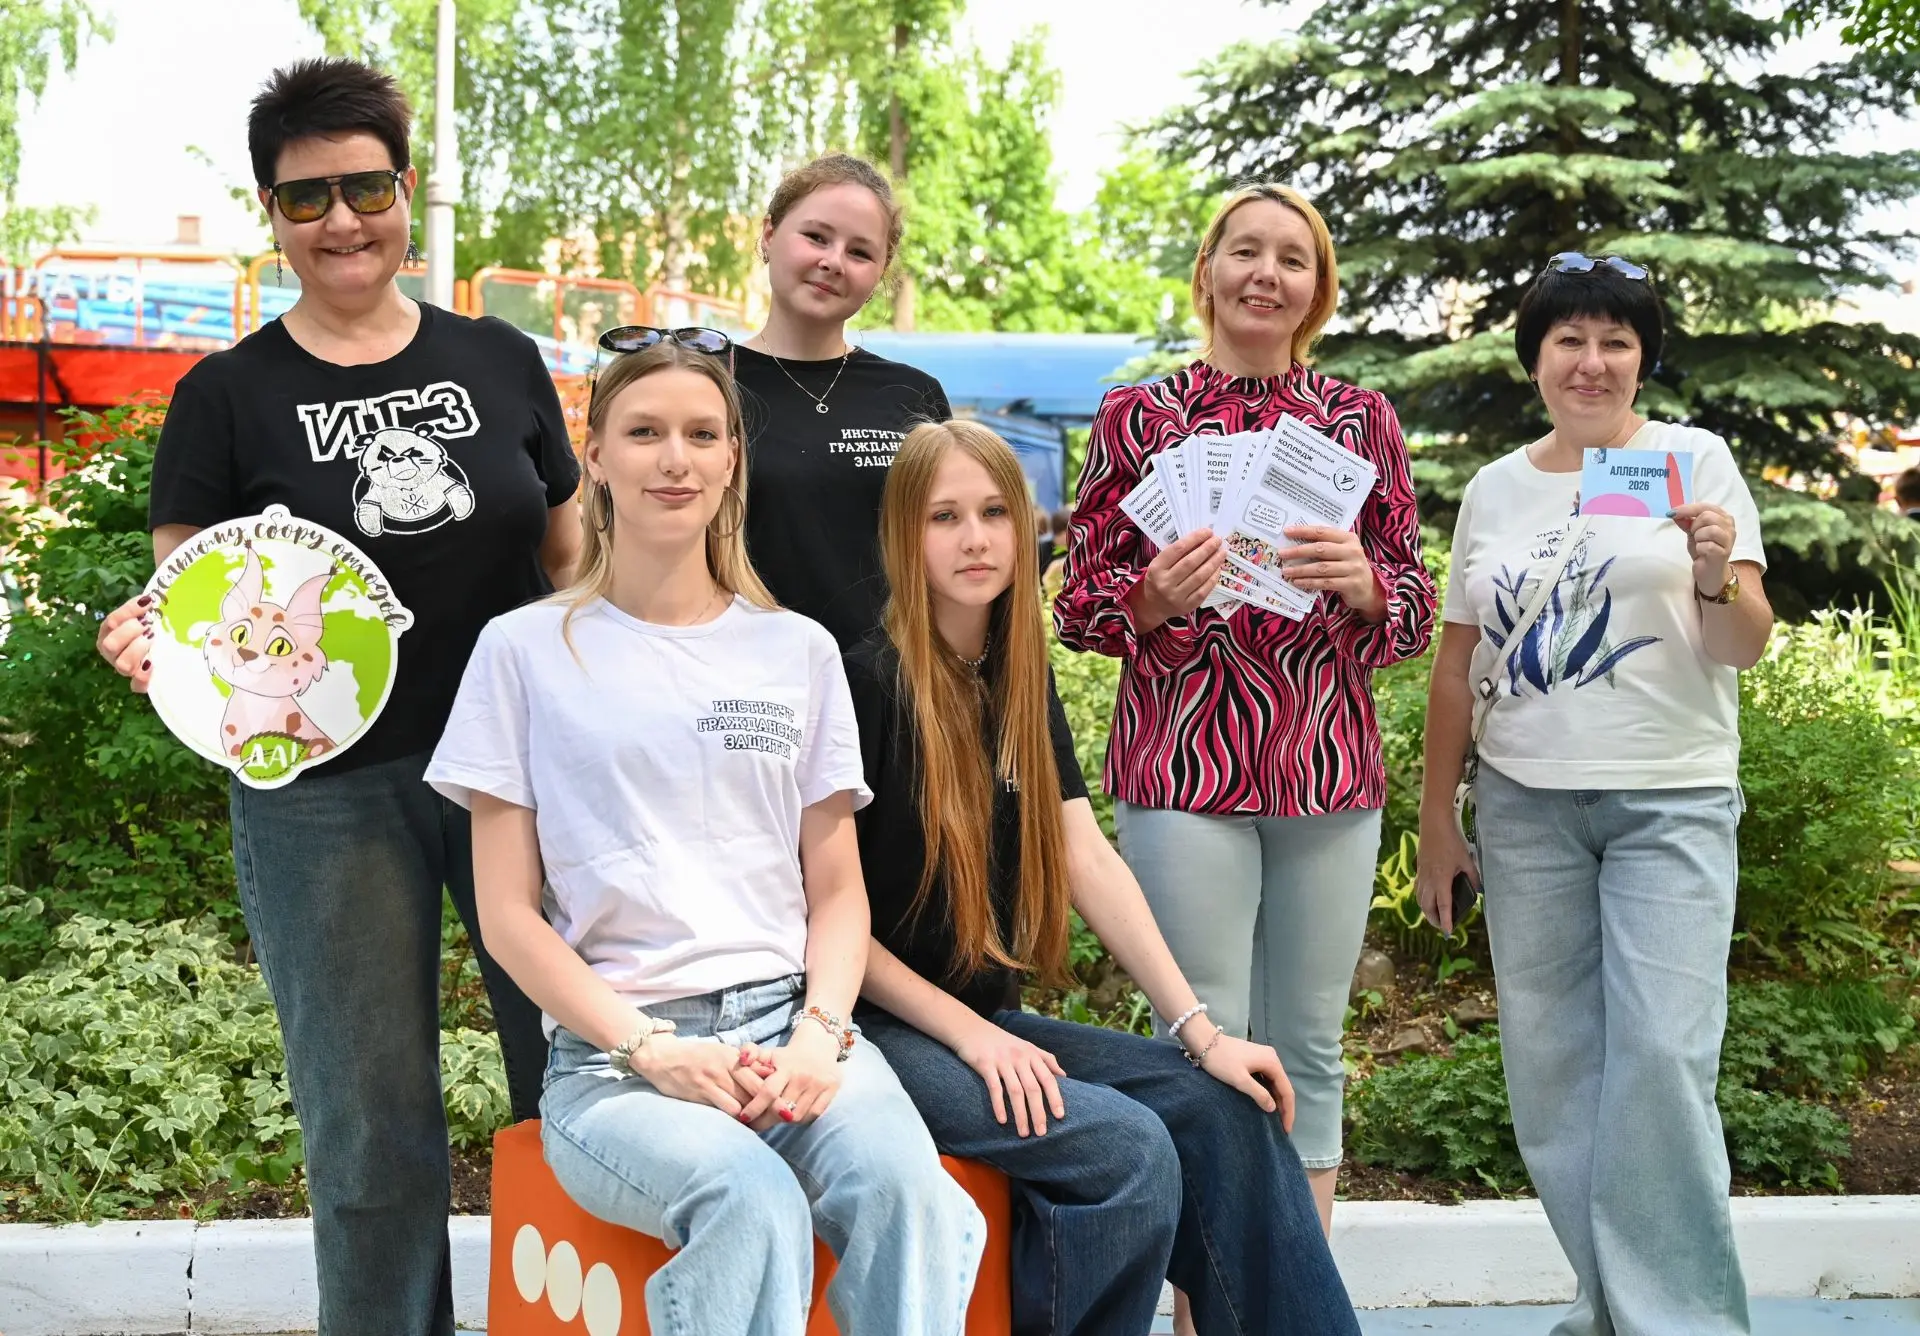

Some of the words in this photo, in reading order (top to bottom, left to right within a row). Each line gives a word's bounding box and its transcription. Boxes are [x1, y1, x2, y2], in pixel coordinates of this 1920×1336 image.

[296, 381, 481, 462] ИГЗ
[1277, 439, 1314, 463] колледж
[1281, 429, 1335, 464] Многопрофильный
[1271, 452, 1308, 475] образования
[1274, 446, 1331, 481] профессионального
[1609, 465, 1639, 478] АЛЛЕЯ
[1640, 467, 1670, 480] ПРОФИ
[1628, 480, 1650, 491] 2026
[254, 511, 328, 550] сбору
[331, 543, 408, 629] отходов
[712, 700, 795, 723] ИНСТИТУТ
[697, 716, 802, 749] ГРАЖДАНСКОЙ
[246, 741, 298, 769] ДА!
[724, 734, 791, 760] ЗАЩИТЫ
